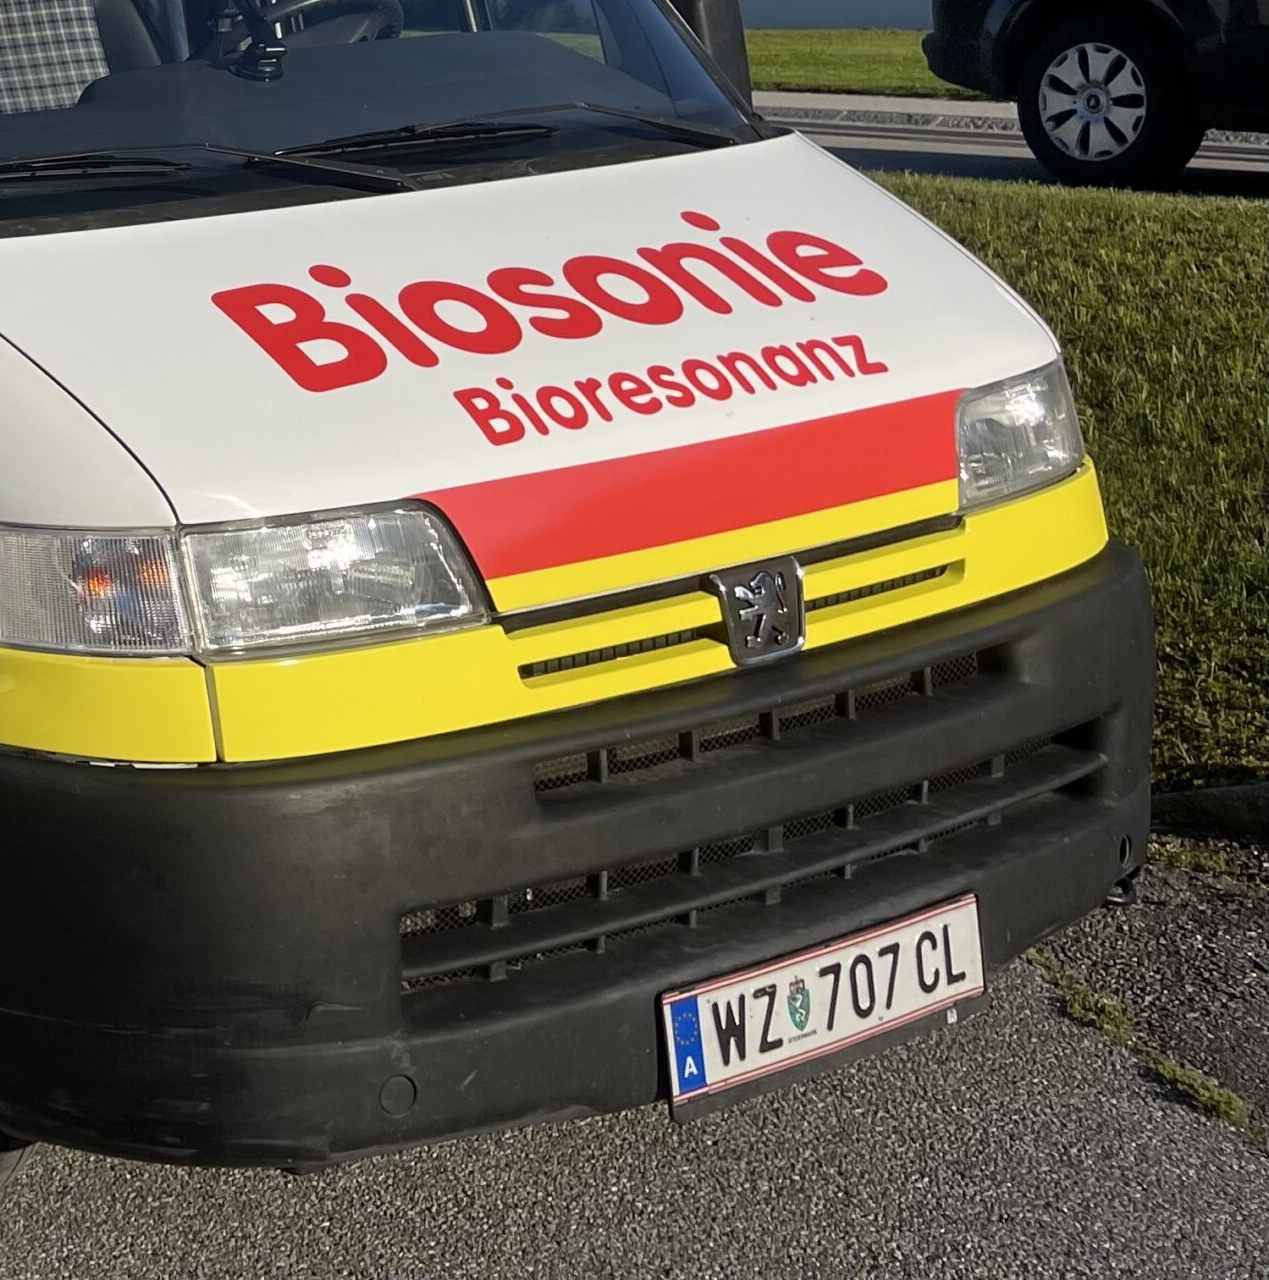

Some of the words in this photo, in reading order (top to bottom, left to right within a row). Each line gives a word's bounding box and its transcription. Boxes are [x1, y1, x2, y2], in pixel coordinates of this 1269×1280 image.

[211, 211, 888, 392] Biosonie
[453, 334, 889, 446] Bioresonanz
[712, 984, 784, 1067] WZ
[818, 942, 900, 1032] 707
[916, 924, 967, 993] CL
[684, 1056, 698, 1078] A
